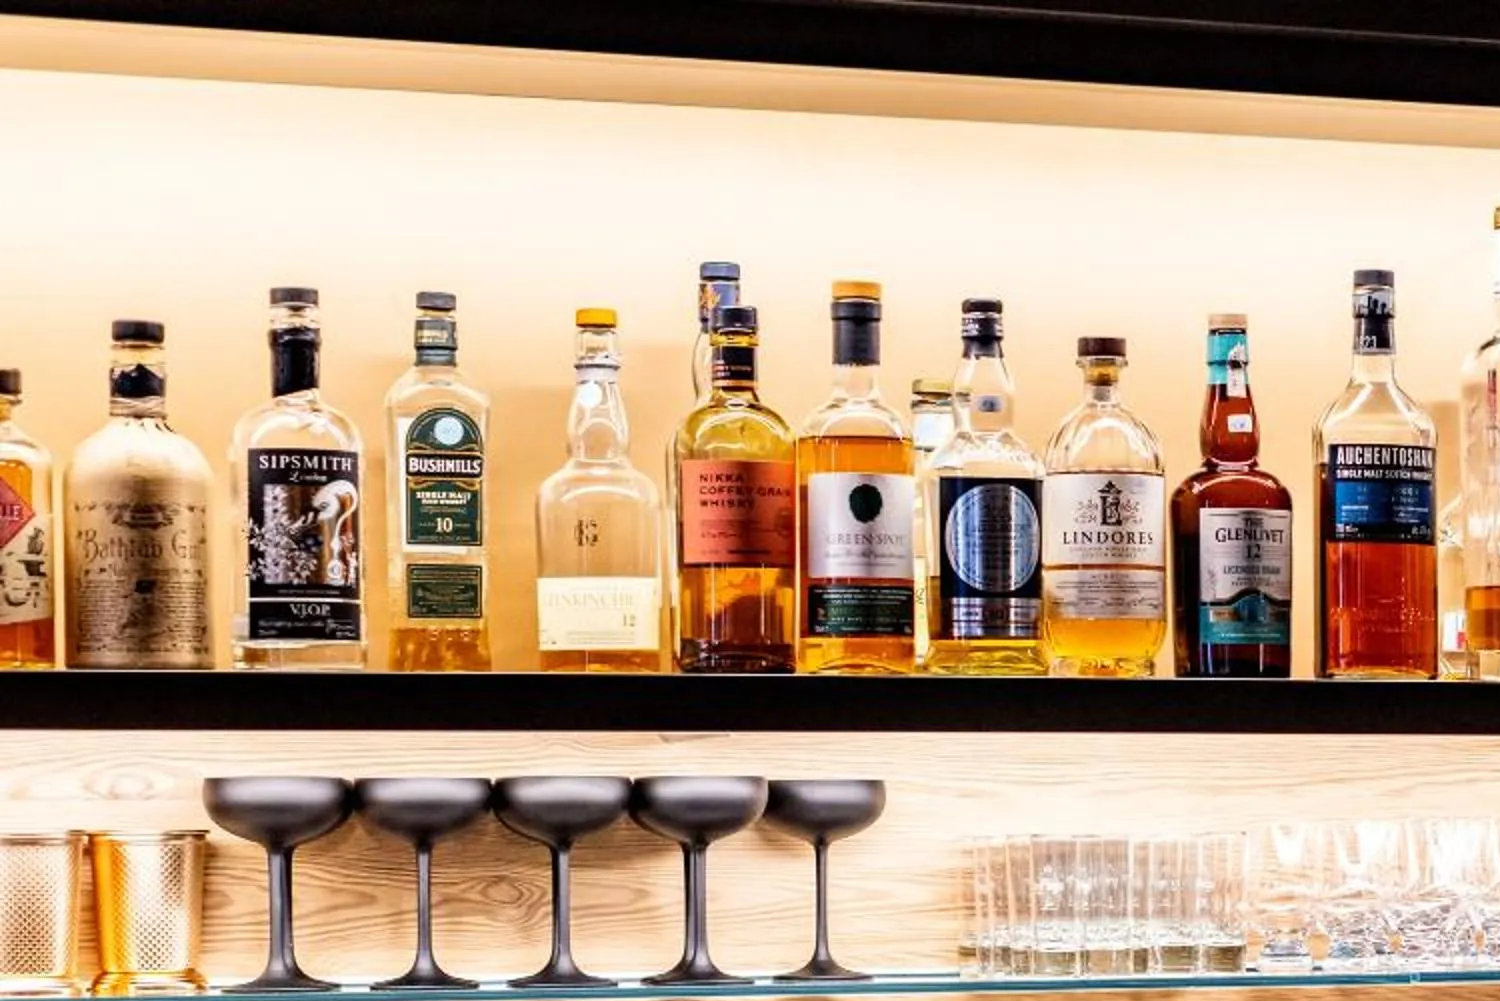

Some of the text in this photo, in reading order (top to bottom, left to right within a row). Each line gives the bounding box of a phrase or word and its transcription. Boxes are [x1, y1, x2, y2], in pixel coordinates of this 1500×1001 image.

[259, 455, 352, 471] SIPSMITH
[409, 457, 481, 474] BUSHMILLS
[700, 474, 744, 483] NIKKA
[436, 517, 453, 533] 10
[1063, 531, 1154, 545] LINDORES
[1215, 528, 1284, 543] GLENLIVET
[1247, 543, 1261, 558] 12
[623, 613, 636, 628] 12
